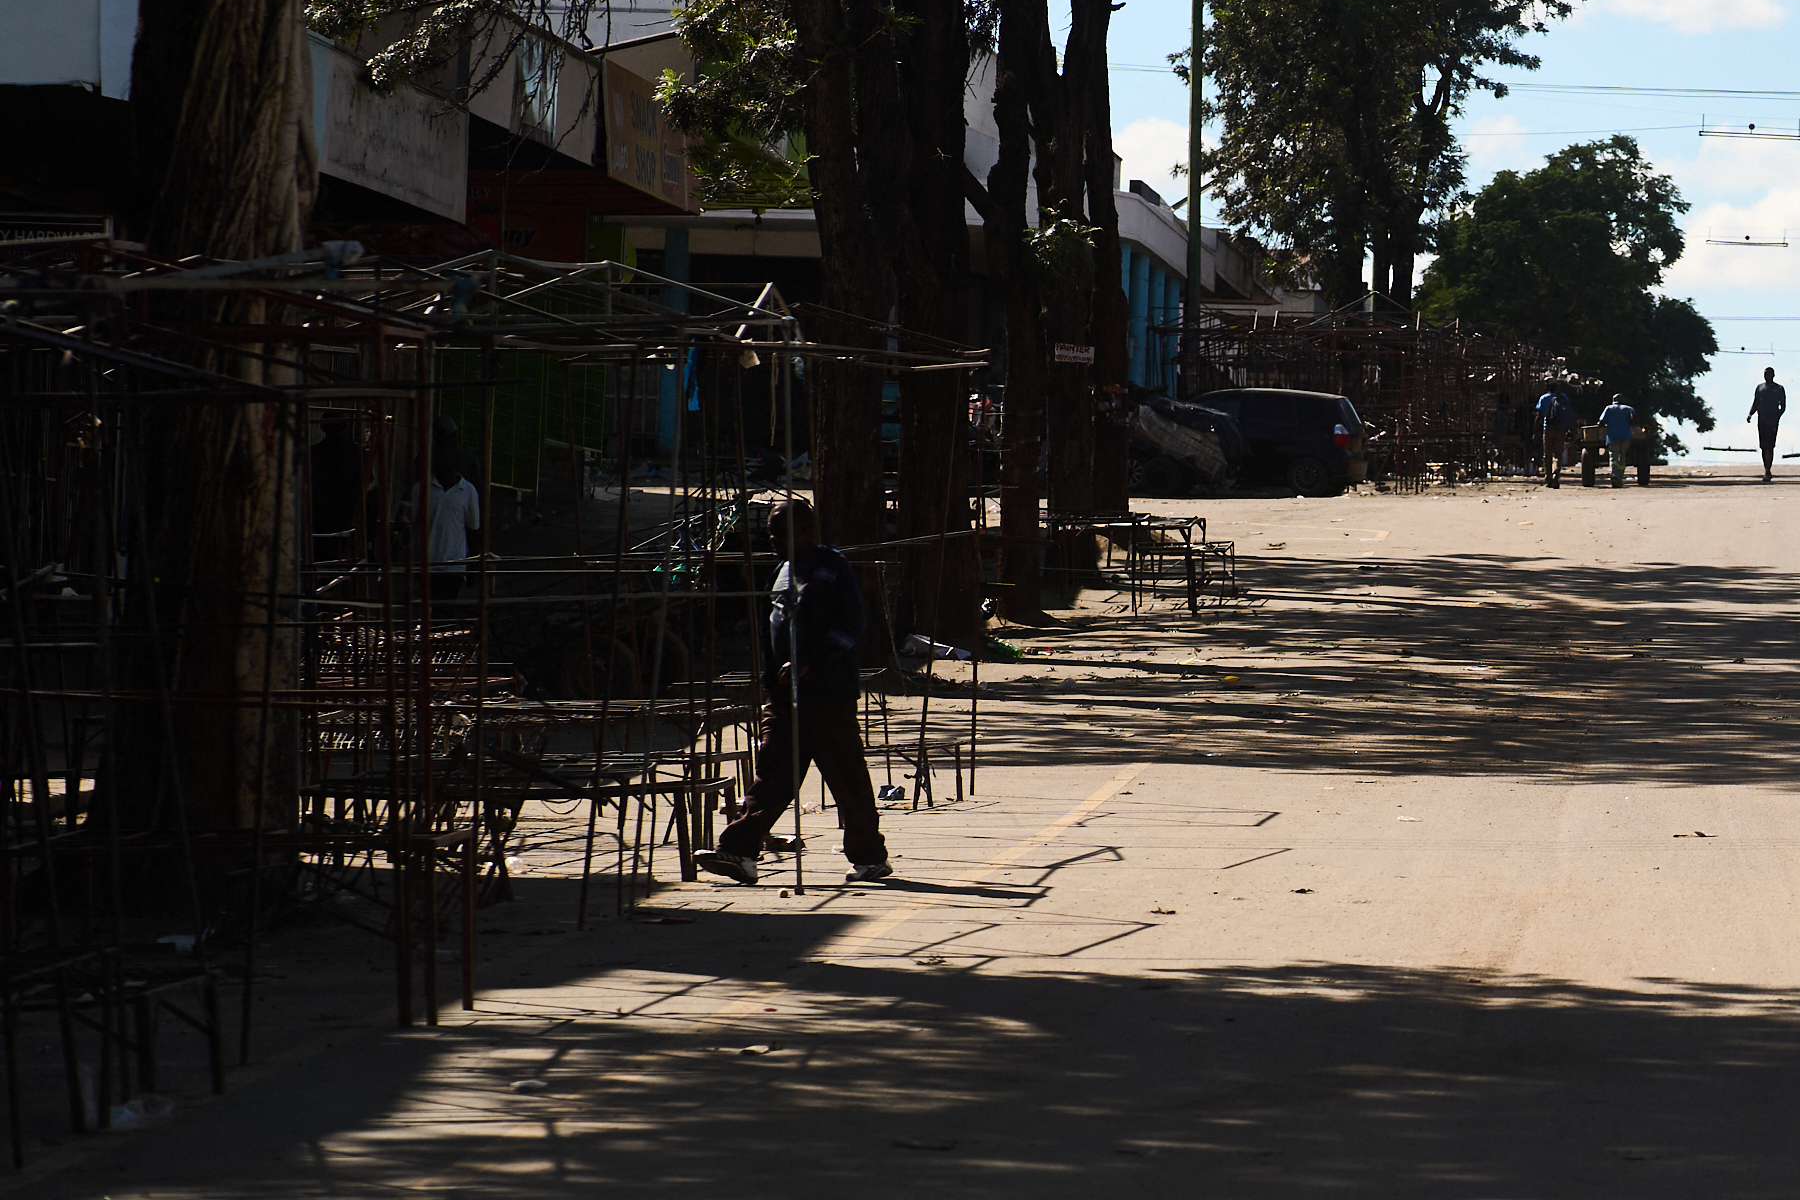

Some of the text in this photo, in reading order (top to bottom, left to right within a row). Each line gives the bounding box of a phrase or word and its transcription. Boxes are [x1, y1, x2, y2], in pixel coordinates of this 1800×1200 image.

[630, 90, 657, 140] SNACK
[635, 143, 656, 189] SHOP
[1056, 343, 1090, 353] PAINTER
